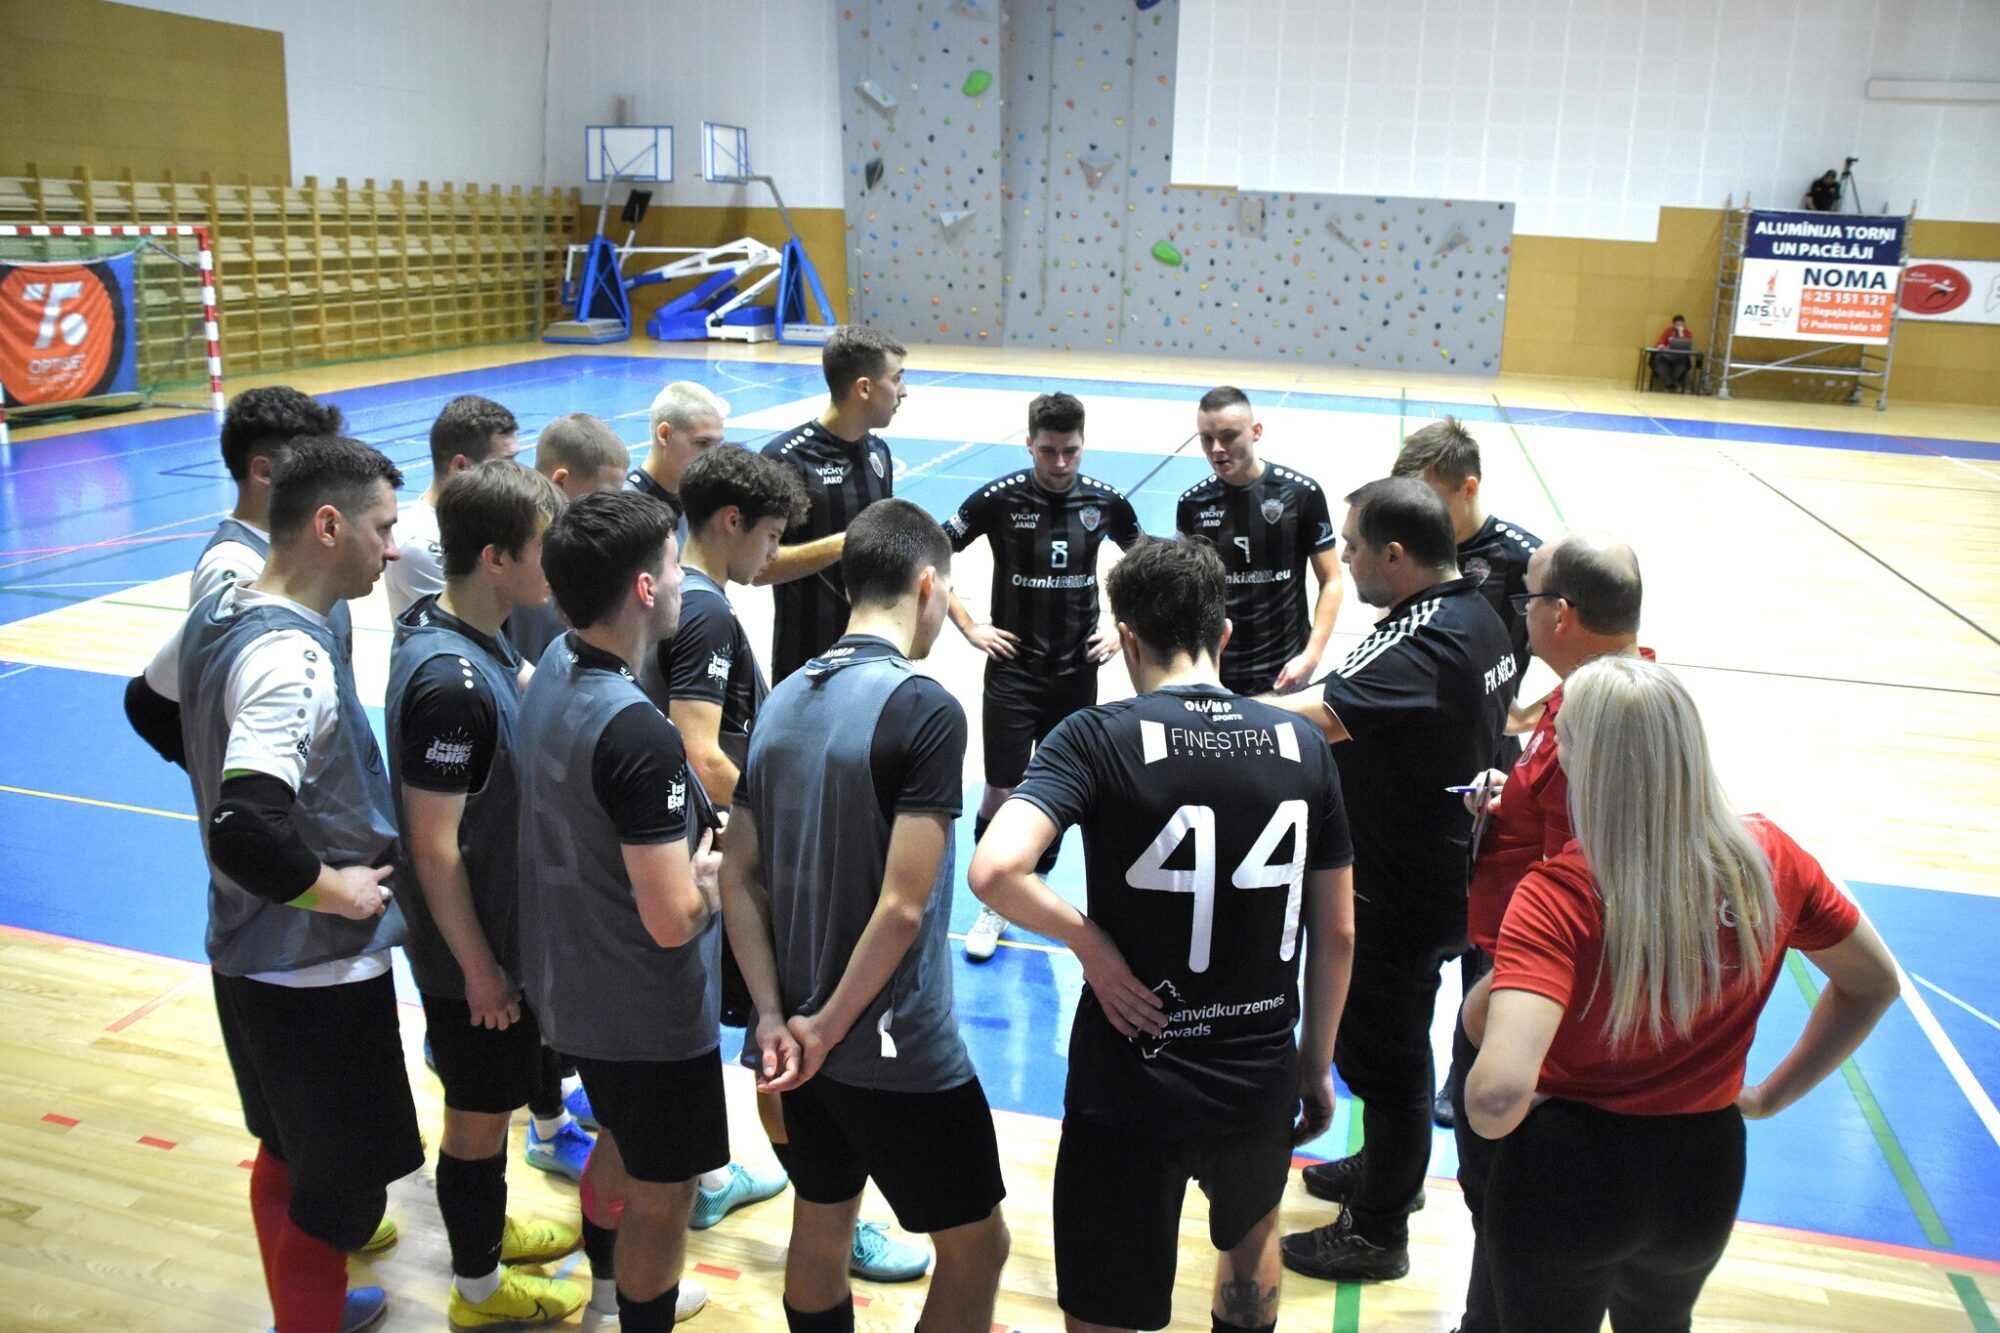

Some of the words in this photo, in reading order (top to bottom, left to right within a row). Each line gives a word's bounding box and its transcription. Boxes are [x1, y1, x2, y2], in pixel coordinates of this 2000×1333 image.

[1755, 220, 1843, 239] ALUMĪNIJA
[1845, 226, 1896, 245] TORŅI
[1772, 242, 1797, 256] UN
[1798, 243, 1874, 260] PACĒLĀJI
[1803, 268, 1887, 289] NOMA
[1814, 291, 1832, 303] 25
[1835, 292, 1858, 304] 151
[1863, 294, 1887, 306] 121
[1744, 305, 1792, 319] ATS.LV
[815, 466, 844, 476] VICHY
[822, 476, 843, 485] JAKO
[1010, 513, 1040, 522] VICHY
[1200, 510, 1225, 519] VICHY
[1014, 521, 1036, 529] JAKO
[1202, 519, 1221, 527] JAKO
[1051, 540, 1068, 569] 8
[1233, 536, 1251, 564] 9
[1484, 667, 1497, 695] FK
[1212, 713, 1243, 722] SPORTS
[1171, 728, 1273, 750] FINESTRA
[1173, 748, 1275, 758] SOLUTION
[1125, 799, 1308, 973] 44
[1168, 994, 1285, 1023] ienvidkurzemes
